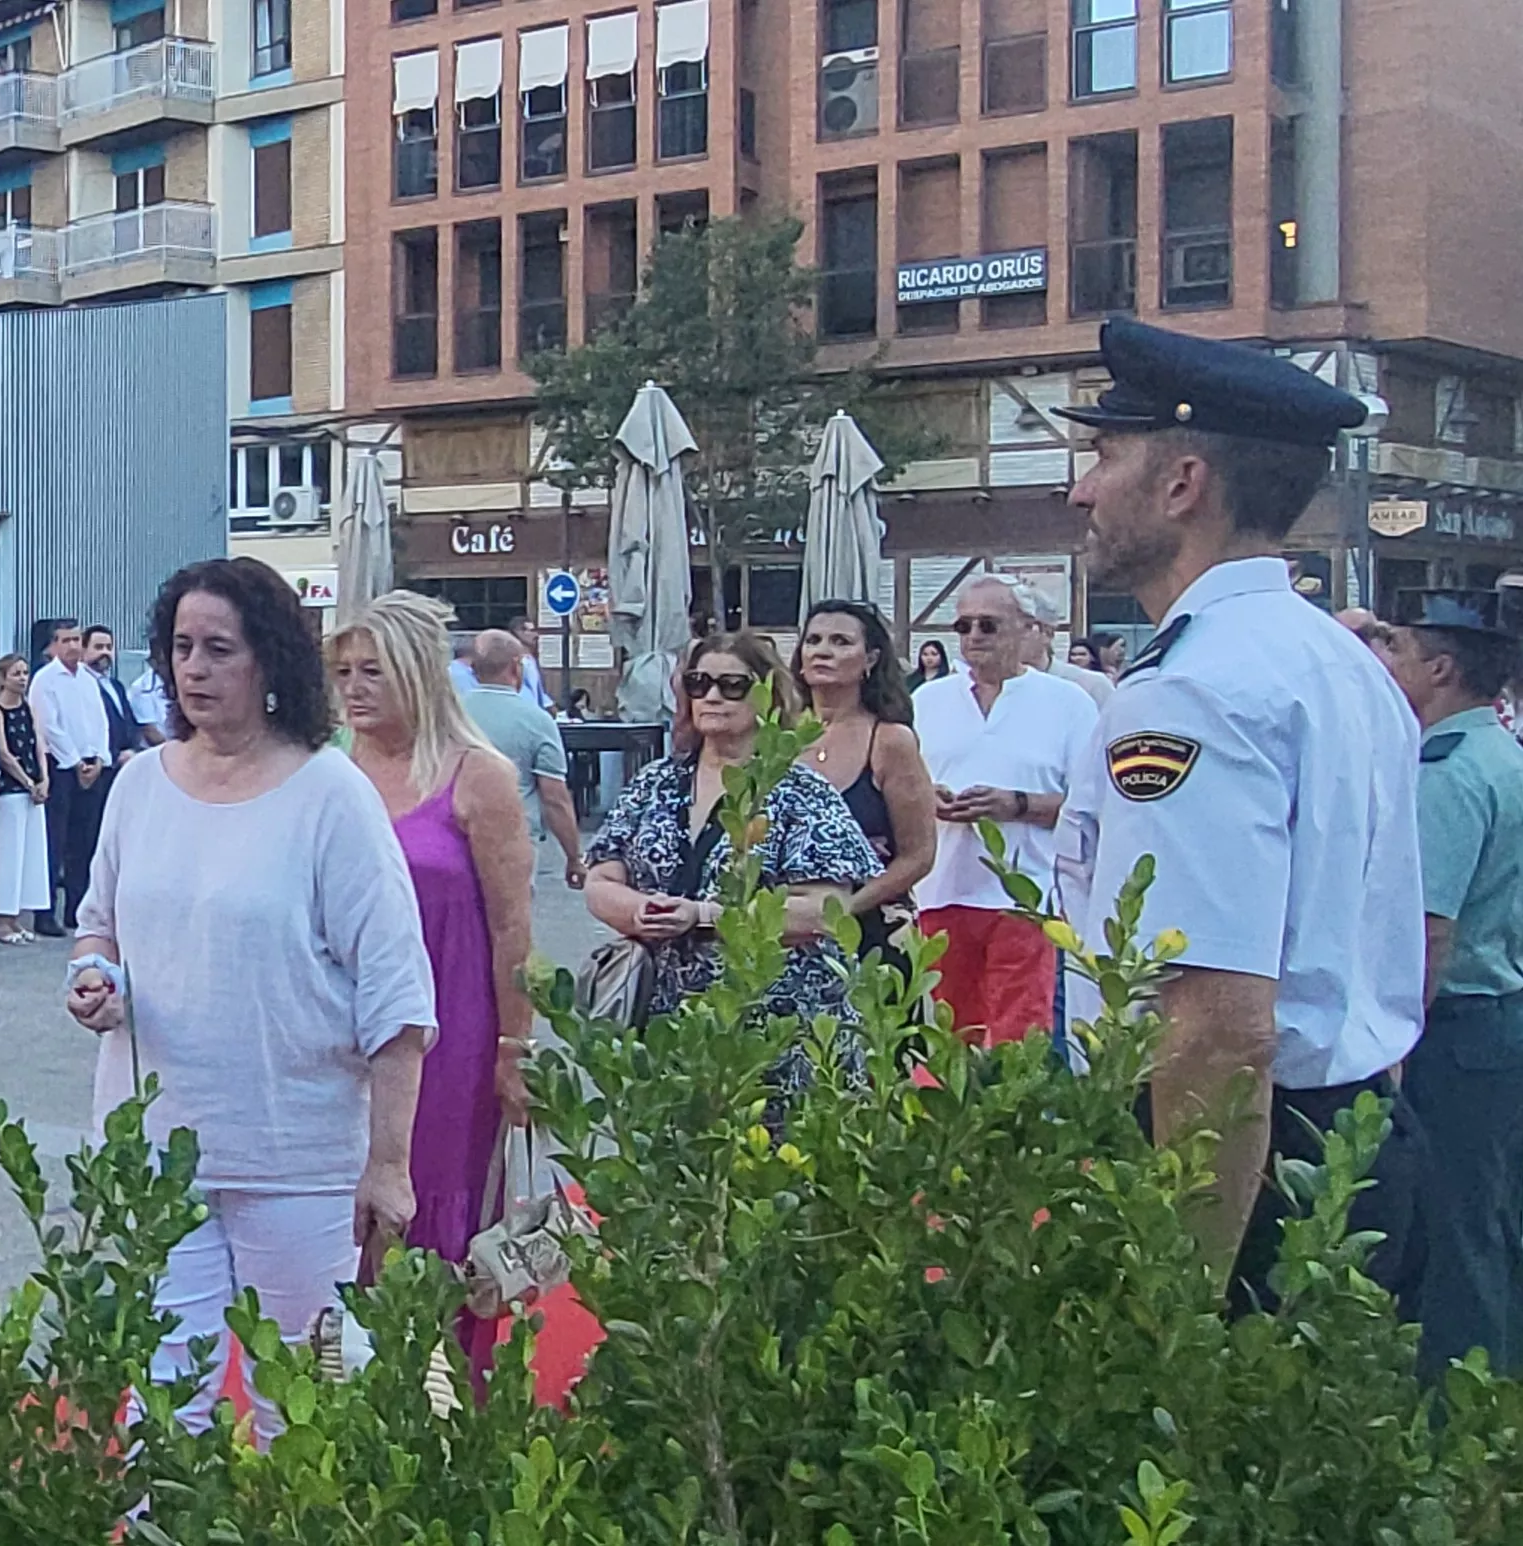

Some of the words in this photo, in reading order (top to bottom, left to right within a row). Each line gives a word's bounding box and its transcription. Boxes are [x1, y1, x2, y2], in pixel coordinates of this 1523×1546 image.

[898, 263, 983, 289] RICARDO
[987, 253, 1043, 279] ORÚS
[898, 286, 958, 302] DESPACHO
[960, 284, 976, 296] DE
[977, 277, 1044, 294] ABOGADOS
[452, 524, 515, 554] Café
